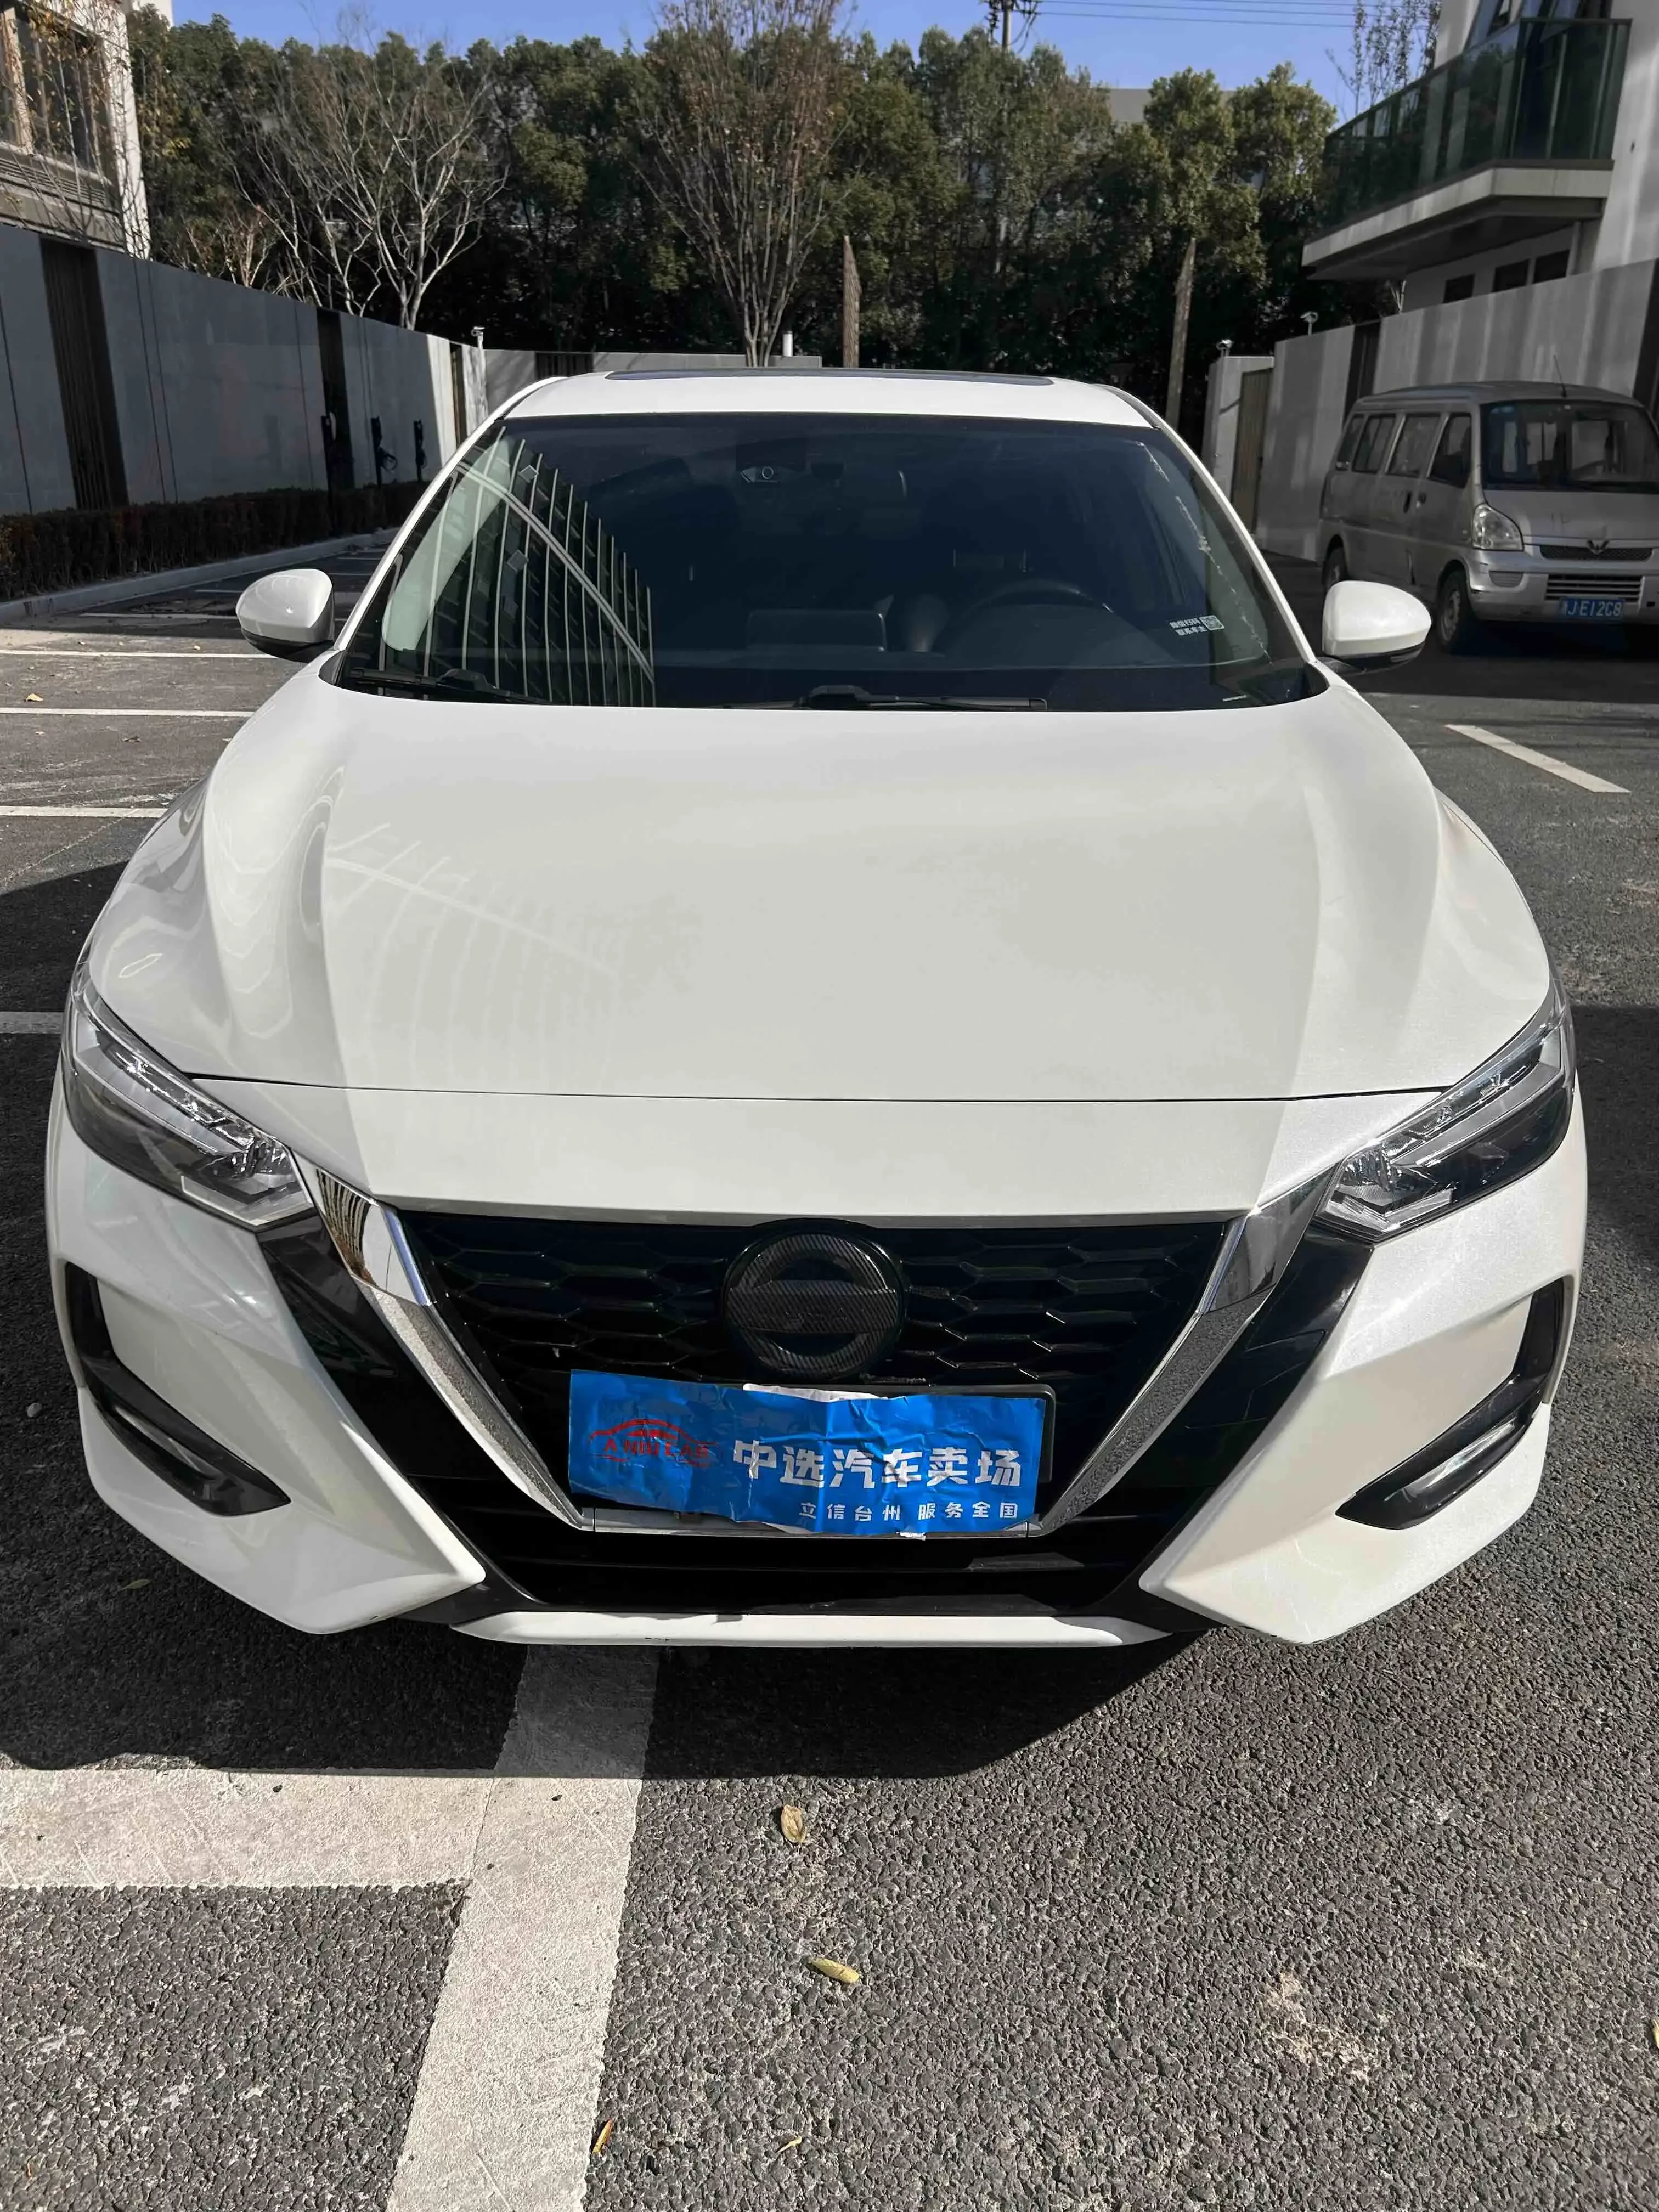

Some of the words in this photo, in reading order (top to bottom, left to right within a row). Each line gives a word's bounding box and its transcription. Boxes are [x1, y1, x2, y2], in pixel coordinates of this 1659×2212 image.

[733, 1440, 1021, 1488] 中选汽车卖场
[799, 1502, 900, 1522] 立信台州
[918, 1500, 1019, 1520] 服务全国
